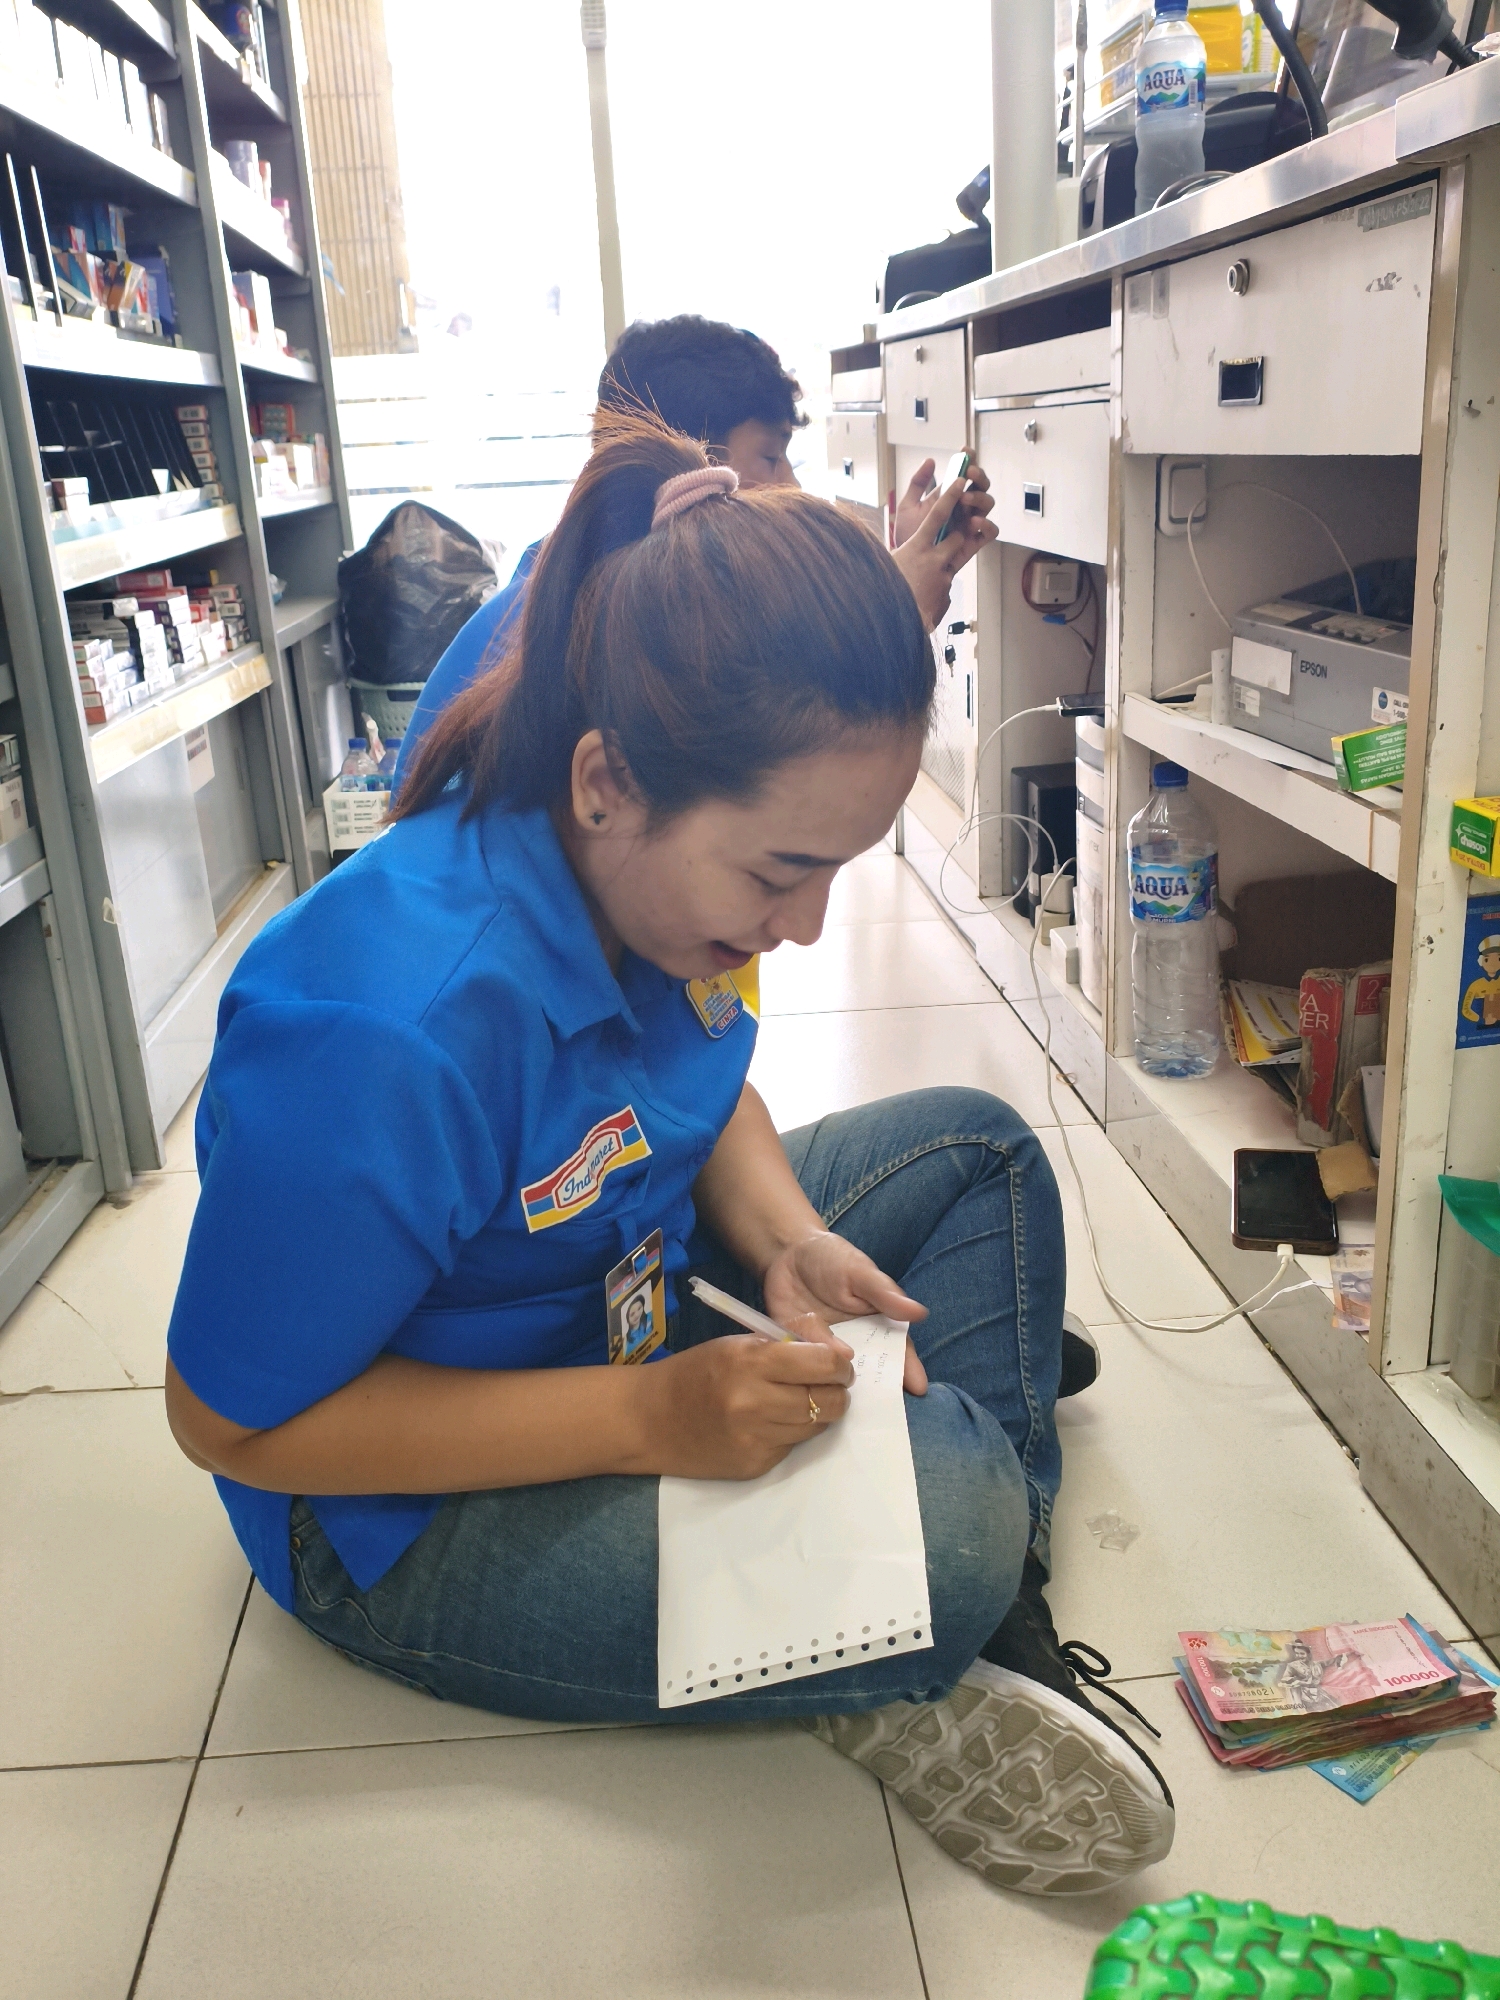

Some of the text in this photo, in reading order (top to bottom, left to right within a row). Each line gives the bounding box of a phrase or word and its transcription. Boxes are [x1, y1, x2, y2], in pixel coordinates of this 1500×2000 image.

[1144, 69, 1185, 91] AQUA
[1300, 660, 1328, 679] EPSON
[1135, 874, 1189, 900] AQUA
[1366, 979, 1380, 1000] 2
[717, 1007, 738, 1030] CINTA
[1383, 1670, 1440, 1688] 100000
